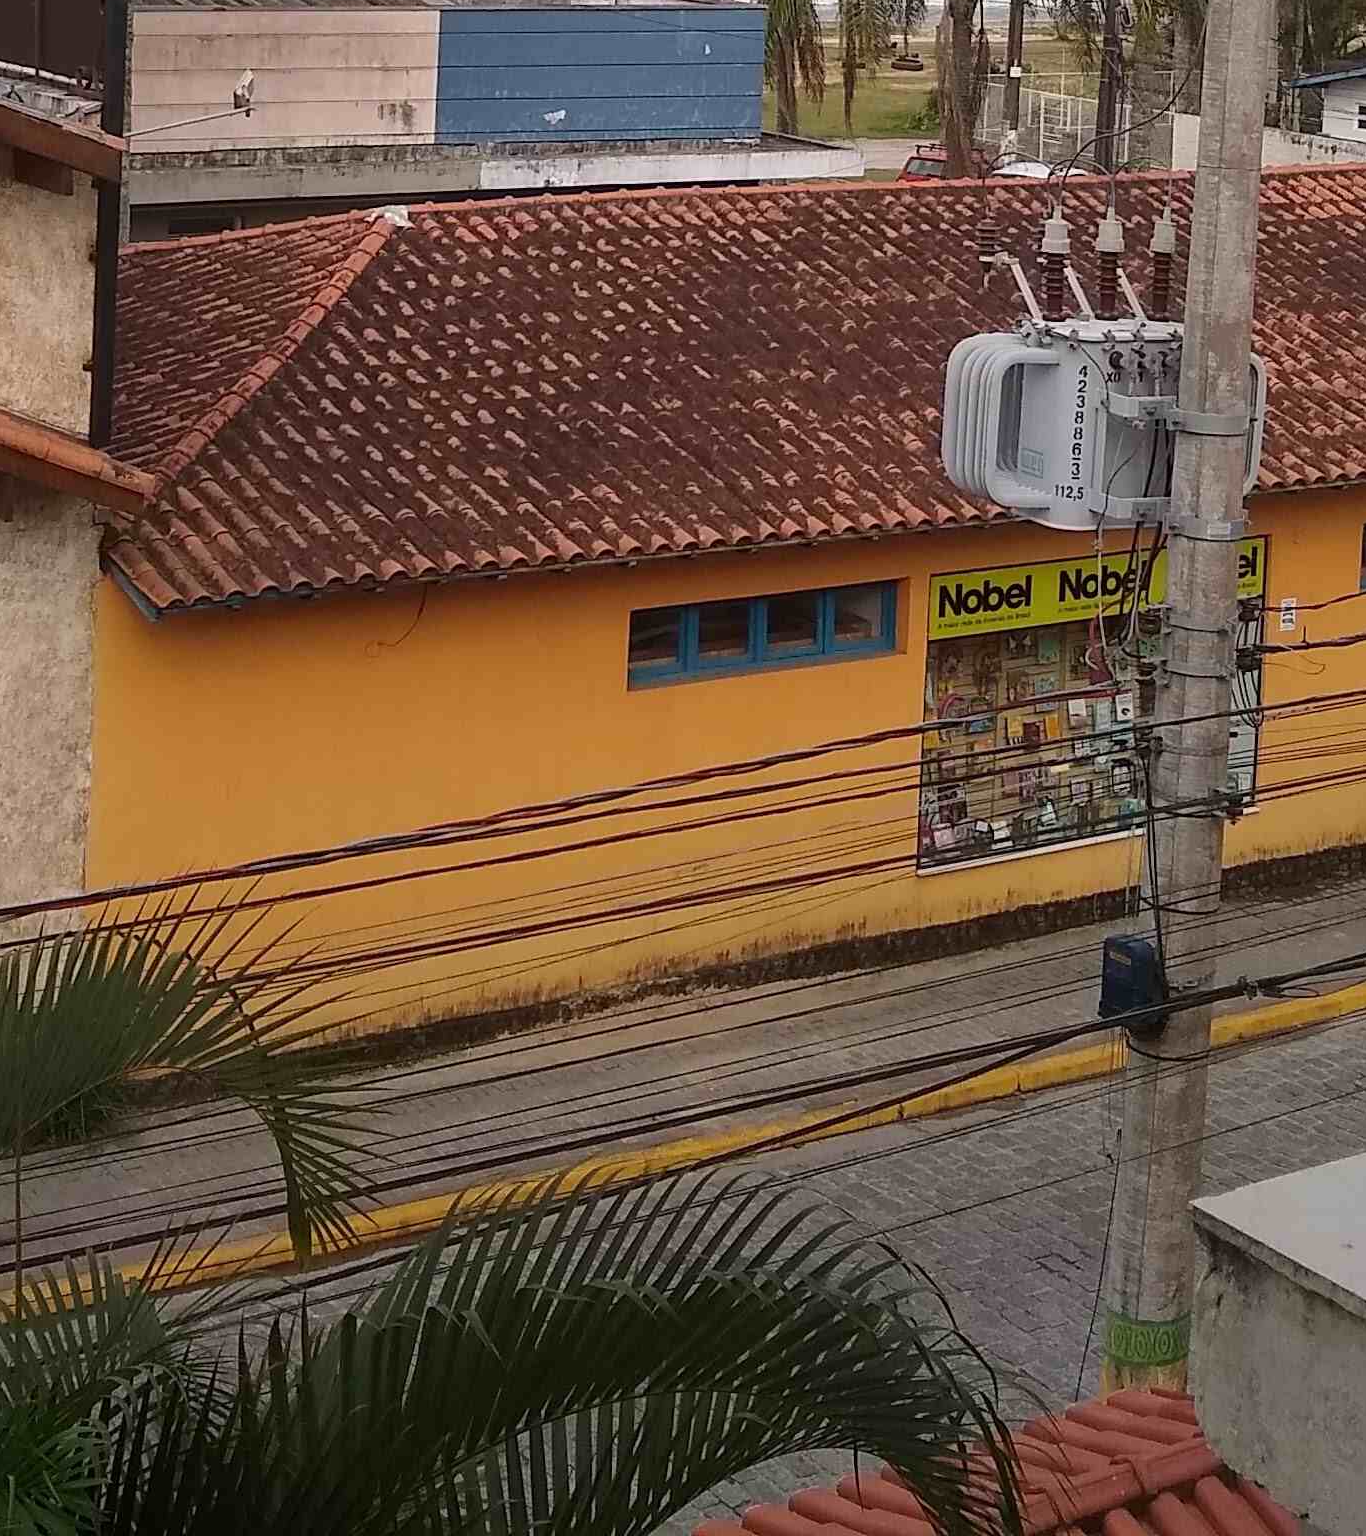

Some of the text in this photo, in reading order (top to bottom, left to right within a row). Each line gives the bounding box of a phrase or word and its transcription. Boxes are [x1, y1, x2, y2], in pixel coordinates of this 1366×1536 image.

[1054, 484, 1084, 502] 112,5
[938, 574, 1033, 618] Nobel
[1058, 560, 1149, 603] Nobel
